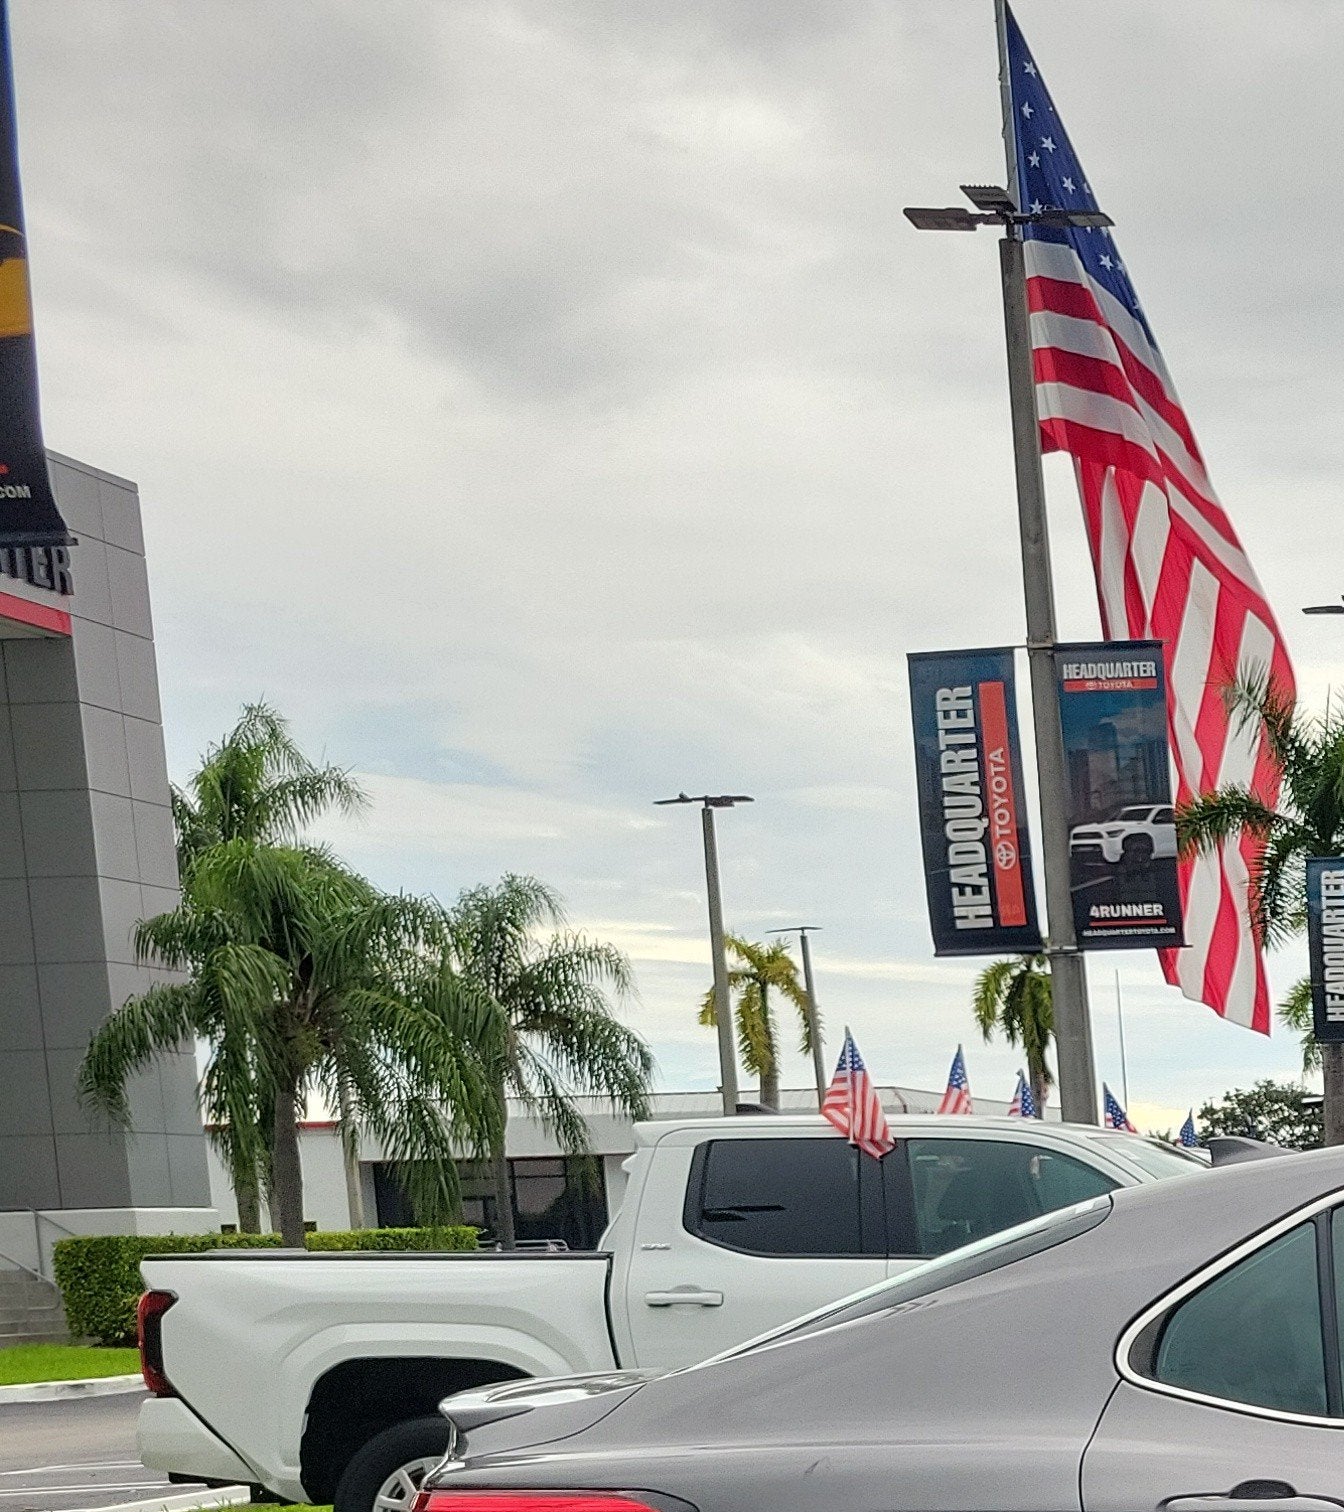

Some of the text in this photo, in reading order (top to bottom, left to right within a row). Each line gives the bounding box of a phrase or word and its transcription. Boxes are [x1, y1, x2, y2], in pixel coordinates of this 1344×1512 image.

[1063, 661, 1157, 680] HEADQUARTER
[1098, 680, 1133, 690] TOYOTA
[989, 747, 1012, 838] TOYOTA
[936, 685, 994, 929] HEADQUARTER
[1090, 903, 1164, 919] 4RUNNER
